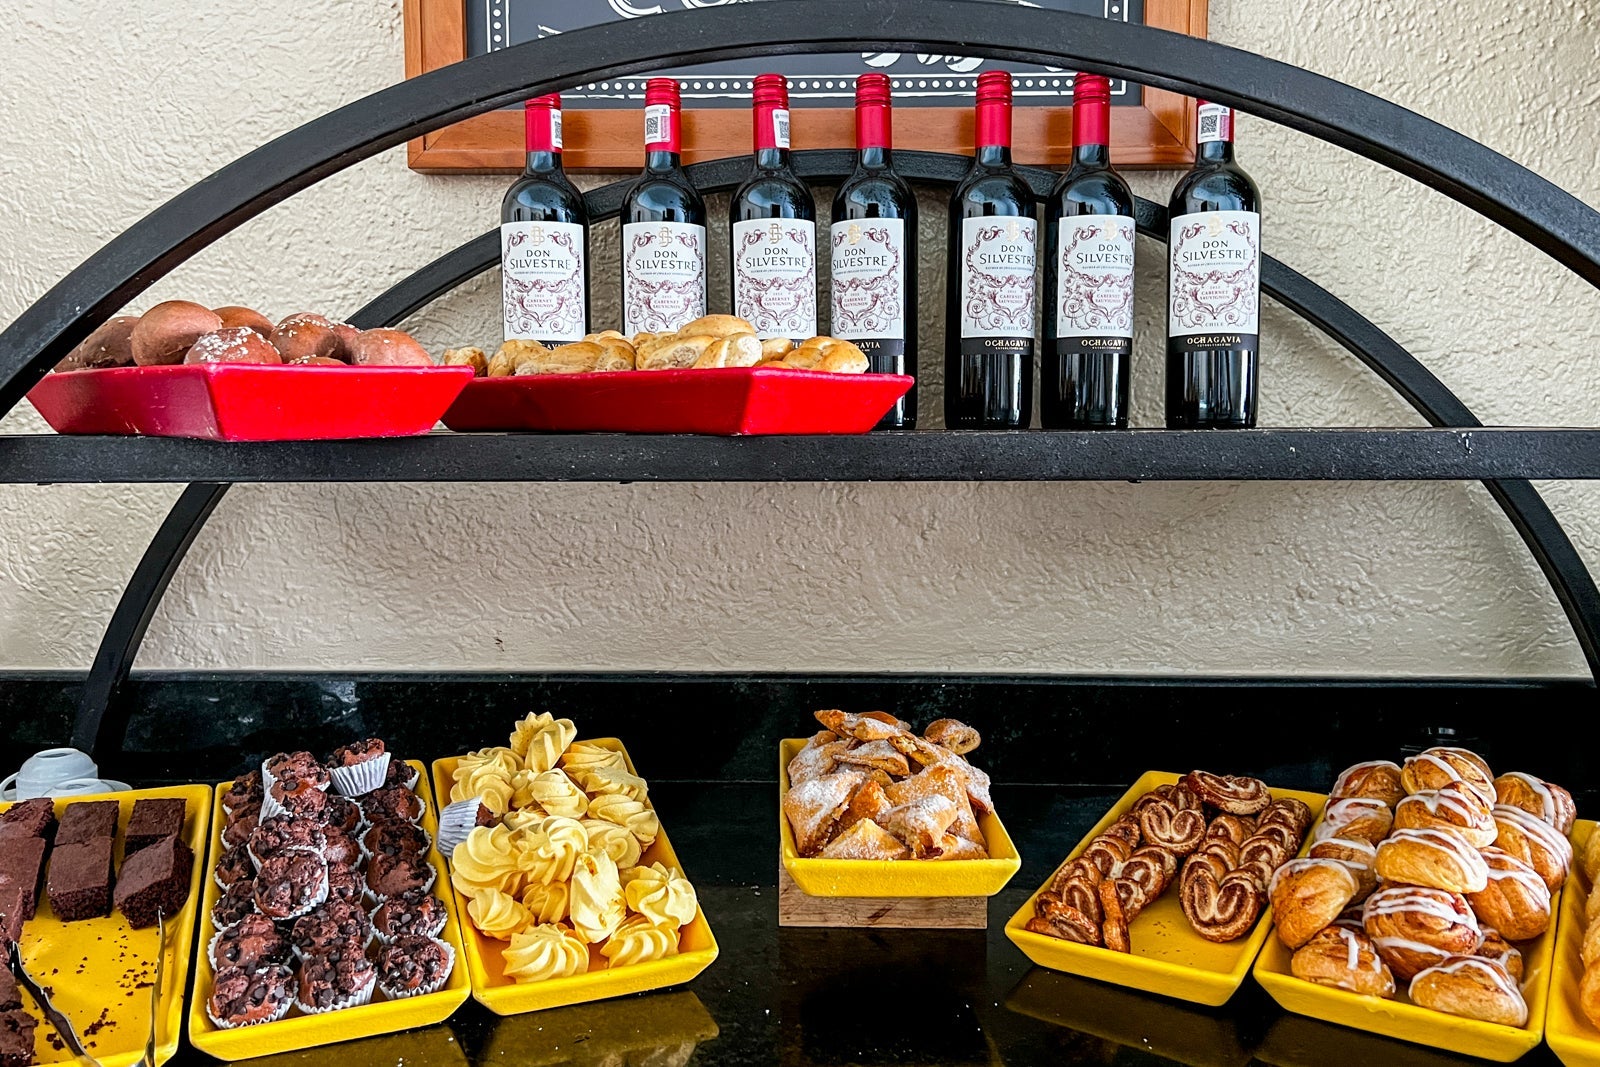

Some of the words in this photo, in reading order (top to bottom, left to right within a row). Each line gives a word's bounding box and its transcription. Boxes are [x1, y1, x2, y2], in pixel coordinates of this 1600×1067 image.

[1203, 240, 1228, 248] DON
[845, 248, 866, 256] DON
[1183, 249, 1248, 262] SILVESTRE
[510, 259, 571, 270] SILVESTRE
[636, 259, 696, 271] SILVESTRE
[746, 256, 806, 268] SILVESTRE
[833, 256, 887, 270] SILVESTRE
[980, 254, 1035, 266] SILVESTRE
[1076, 253, 1132, 265] SILVESTRE
[1187, 336, 1241, 344] OCHAGAVIA
